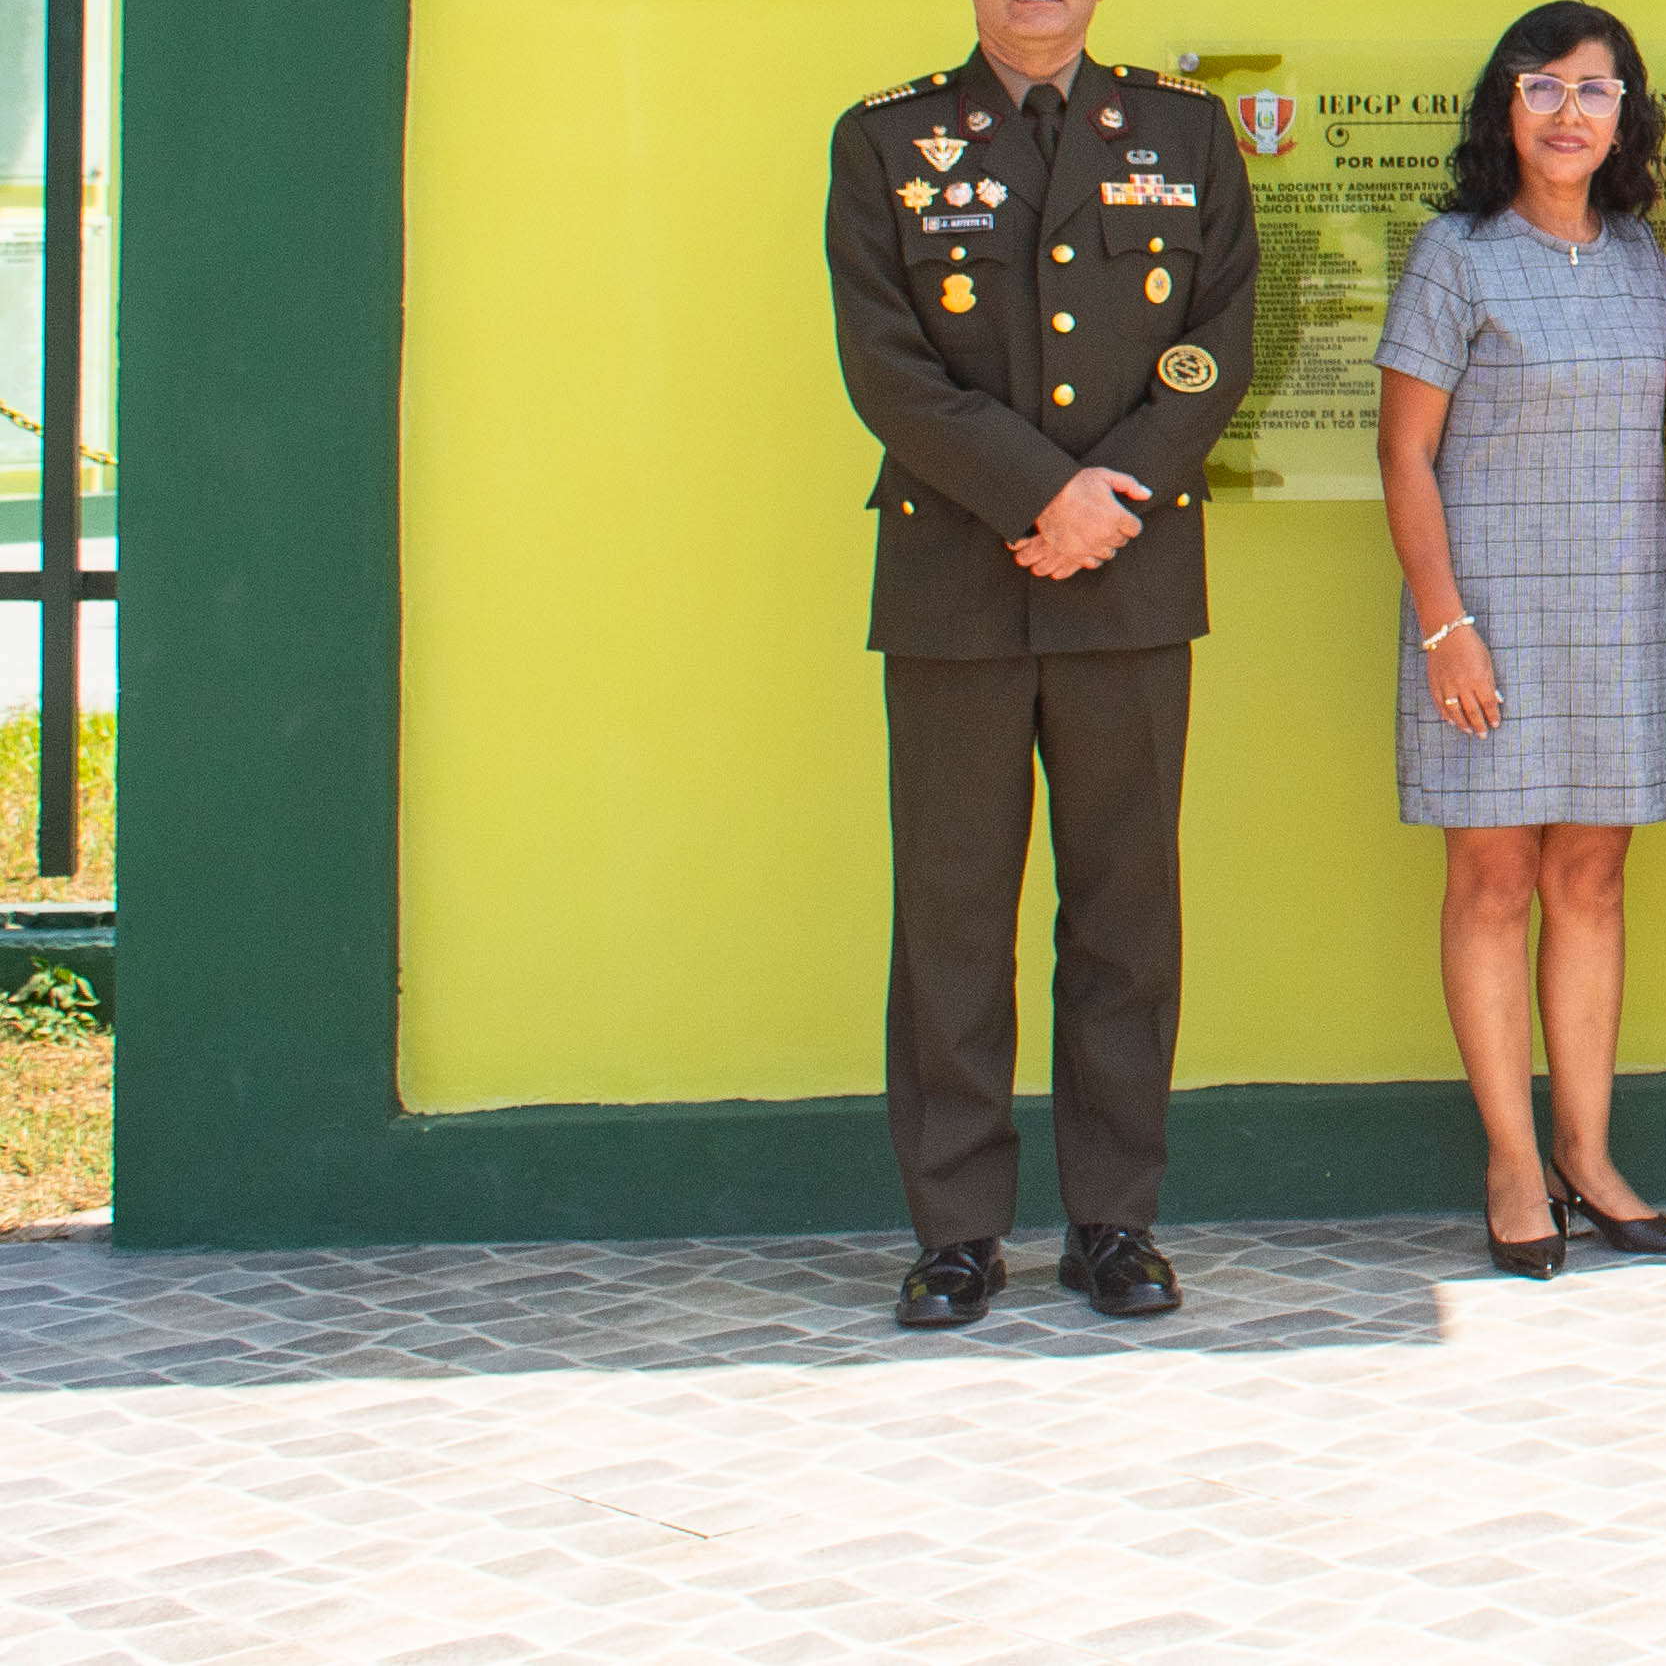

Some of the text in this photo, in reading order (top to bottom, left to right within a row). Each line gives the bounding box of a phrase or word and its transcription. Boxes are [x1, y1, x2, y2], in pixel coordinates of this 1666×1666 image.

[1318, 94, 1401, 114] IEPGP
[1336, 156, 1373, 168] POR
[1380, 156, 1440, 168] MEDIO
[1278, 182, 1332, 192] DOCENTE
[1319, 193, 1340, 202] DEL
[1344, 193, 1395, 202] SISTEMA
[1400, 193, 1415, 202] DE
[1259, 409, 1317, 419] DIRECTOR
[1321, 409, 1335, 419] DE
[1341, 409, 1354, 419] LA
